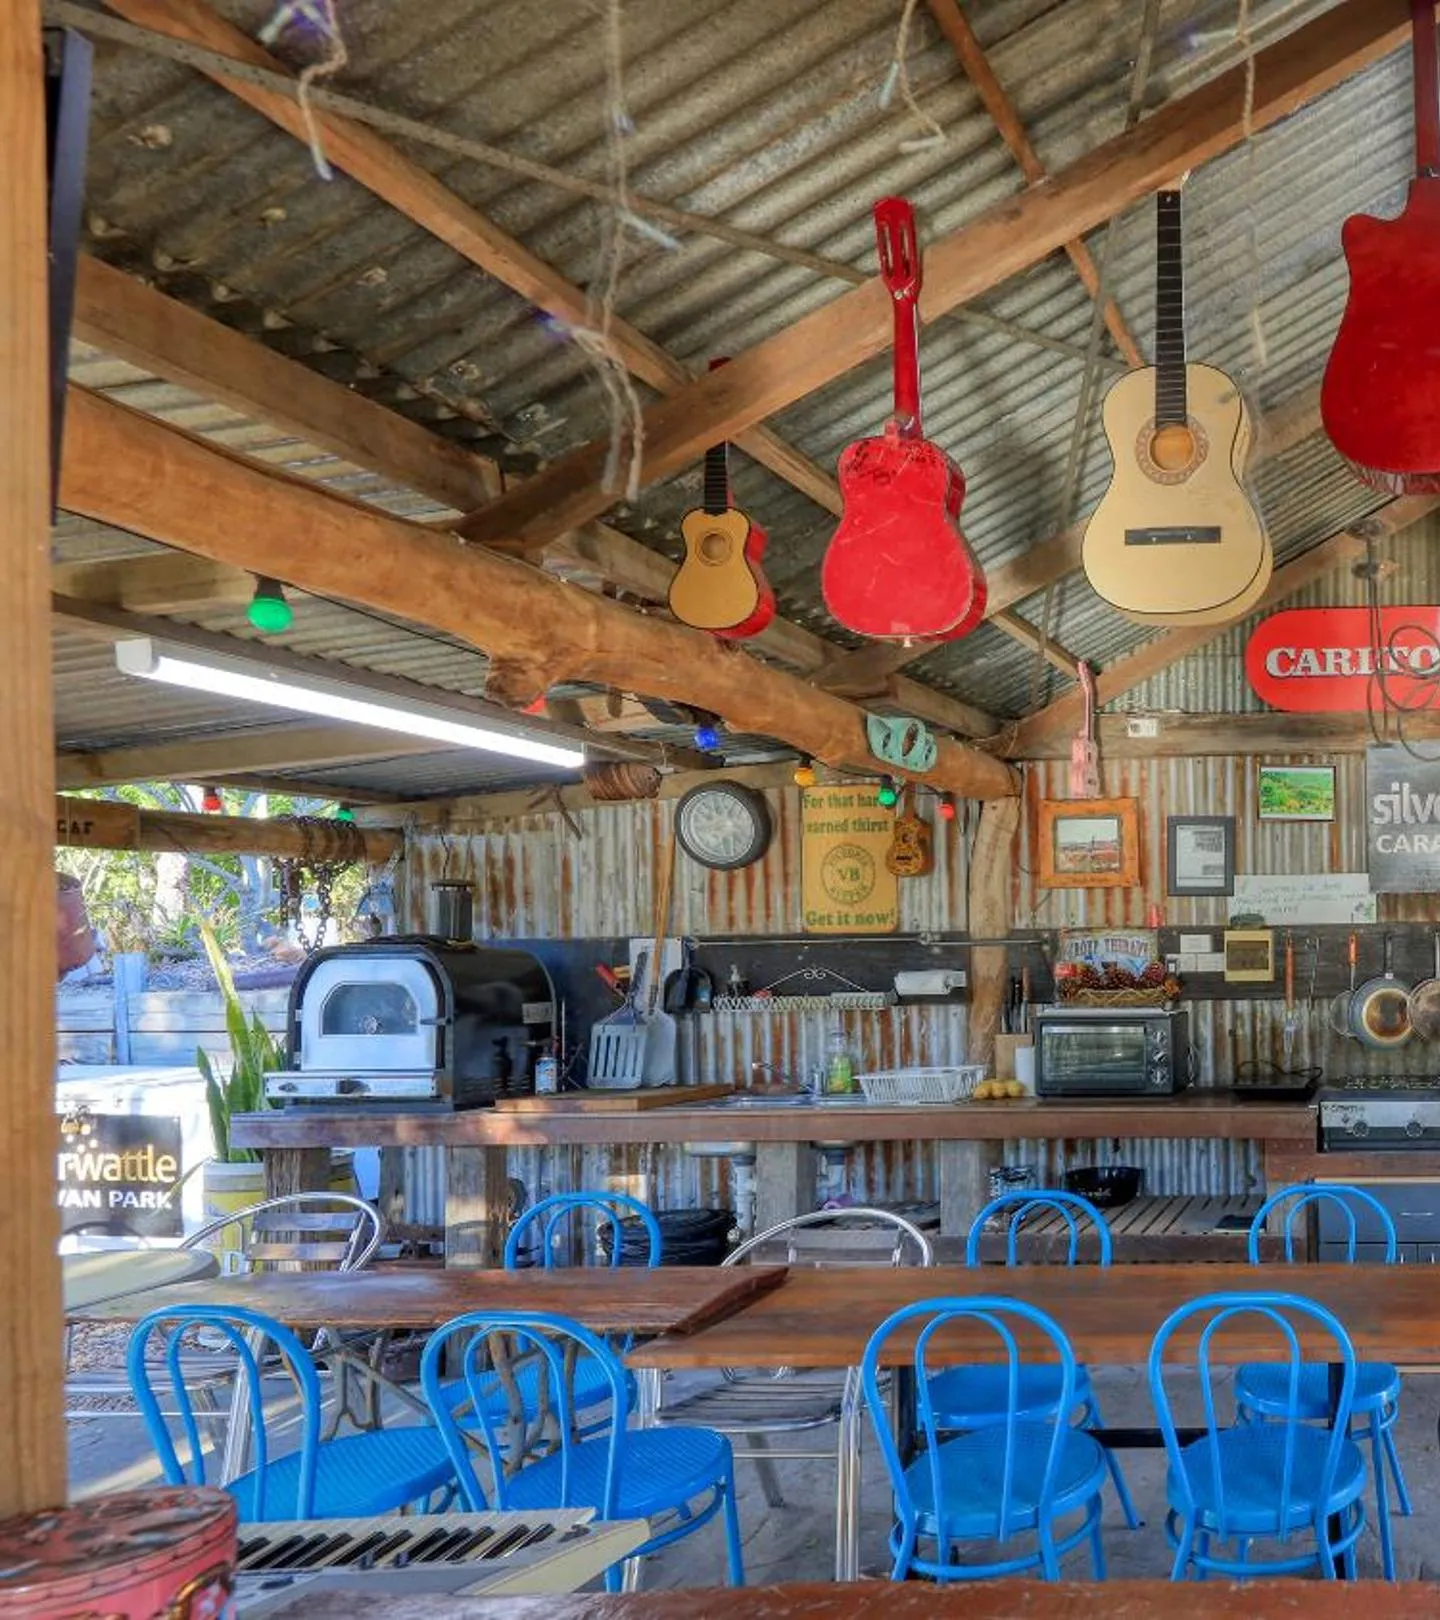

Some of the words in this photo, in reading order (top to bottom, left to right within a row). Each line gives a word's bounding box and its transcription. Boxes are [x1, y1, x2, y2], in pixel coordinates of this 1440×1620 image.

[828, 793, 854, 808] that
[806, 820, 849, 833] earned
[852, 818, 889, 833] thirst
[838, 867, 860, 881] VB
[806, 911, 832, 926] Get
[837, 911, 849, 925] it
[855, 909, 895, 925] now!
[58, 1144, 177, 1183] rwattle
[109, 1190, 173, 1209] PARK
